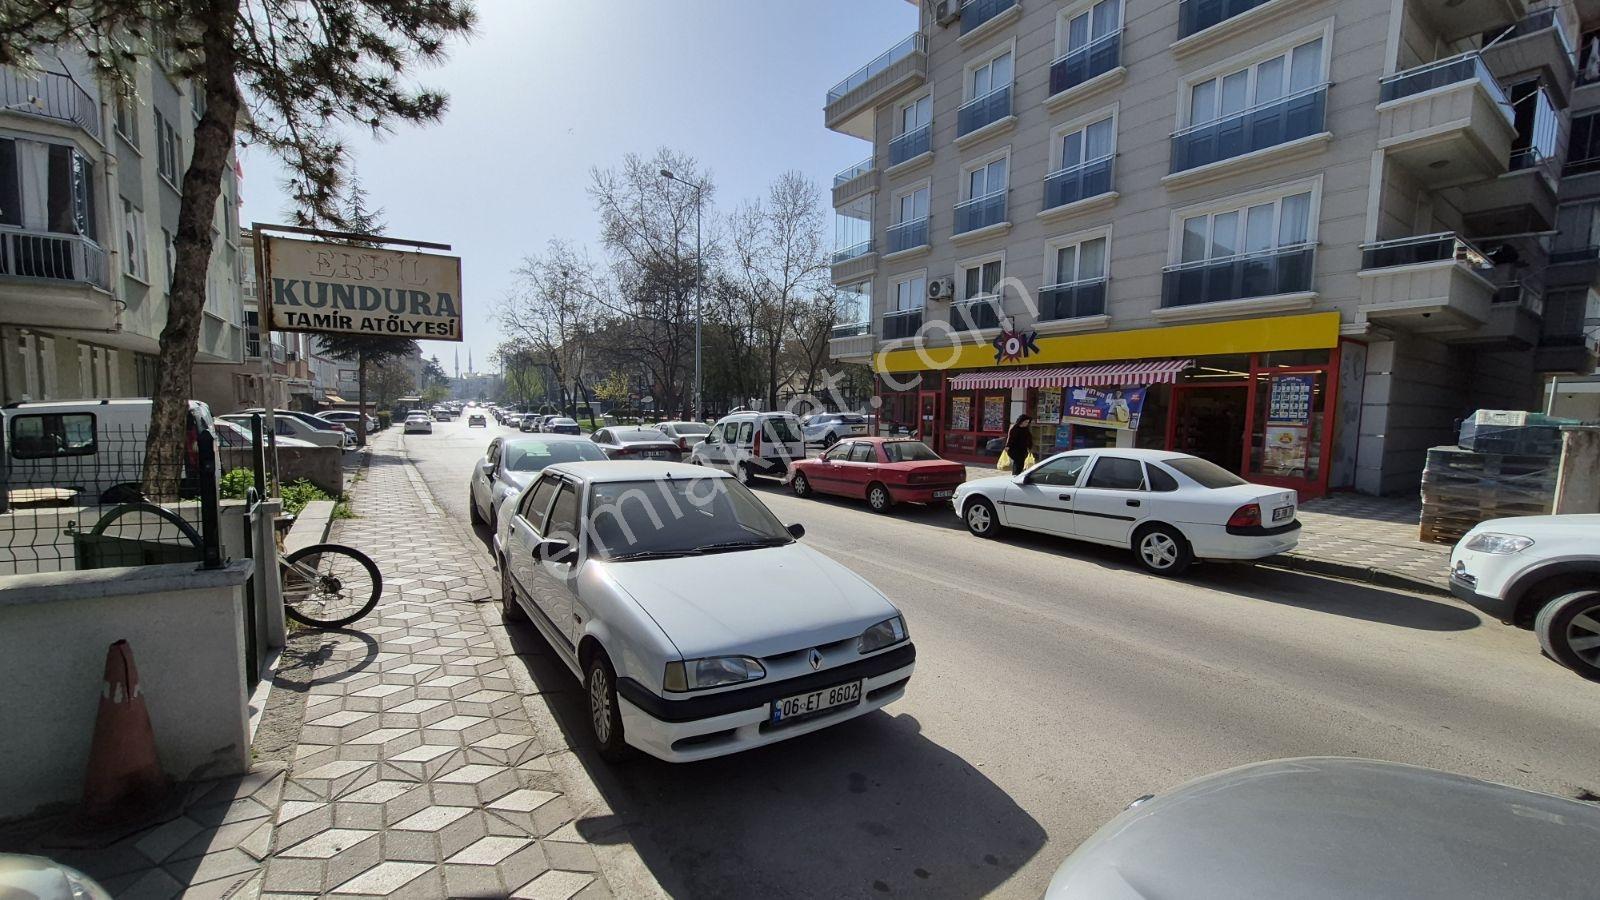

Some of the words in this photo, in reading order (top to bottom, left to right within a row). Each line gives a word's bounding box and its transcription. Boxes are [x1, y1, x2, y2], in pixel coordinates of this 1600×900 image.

[272, 277, 460, 318] KUNDURA
[284, 310, 353, 330] TAMİR
[360, 315, 455, 336] ATÖLYESİ
[993, 331, 1040, 365] ŞOK
[1069, 405, 1086, 416] 125
[783, 698, 800, 716] 06
[806, 692, 823, 711] ET
[829, 683, 859, 705] 8602
